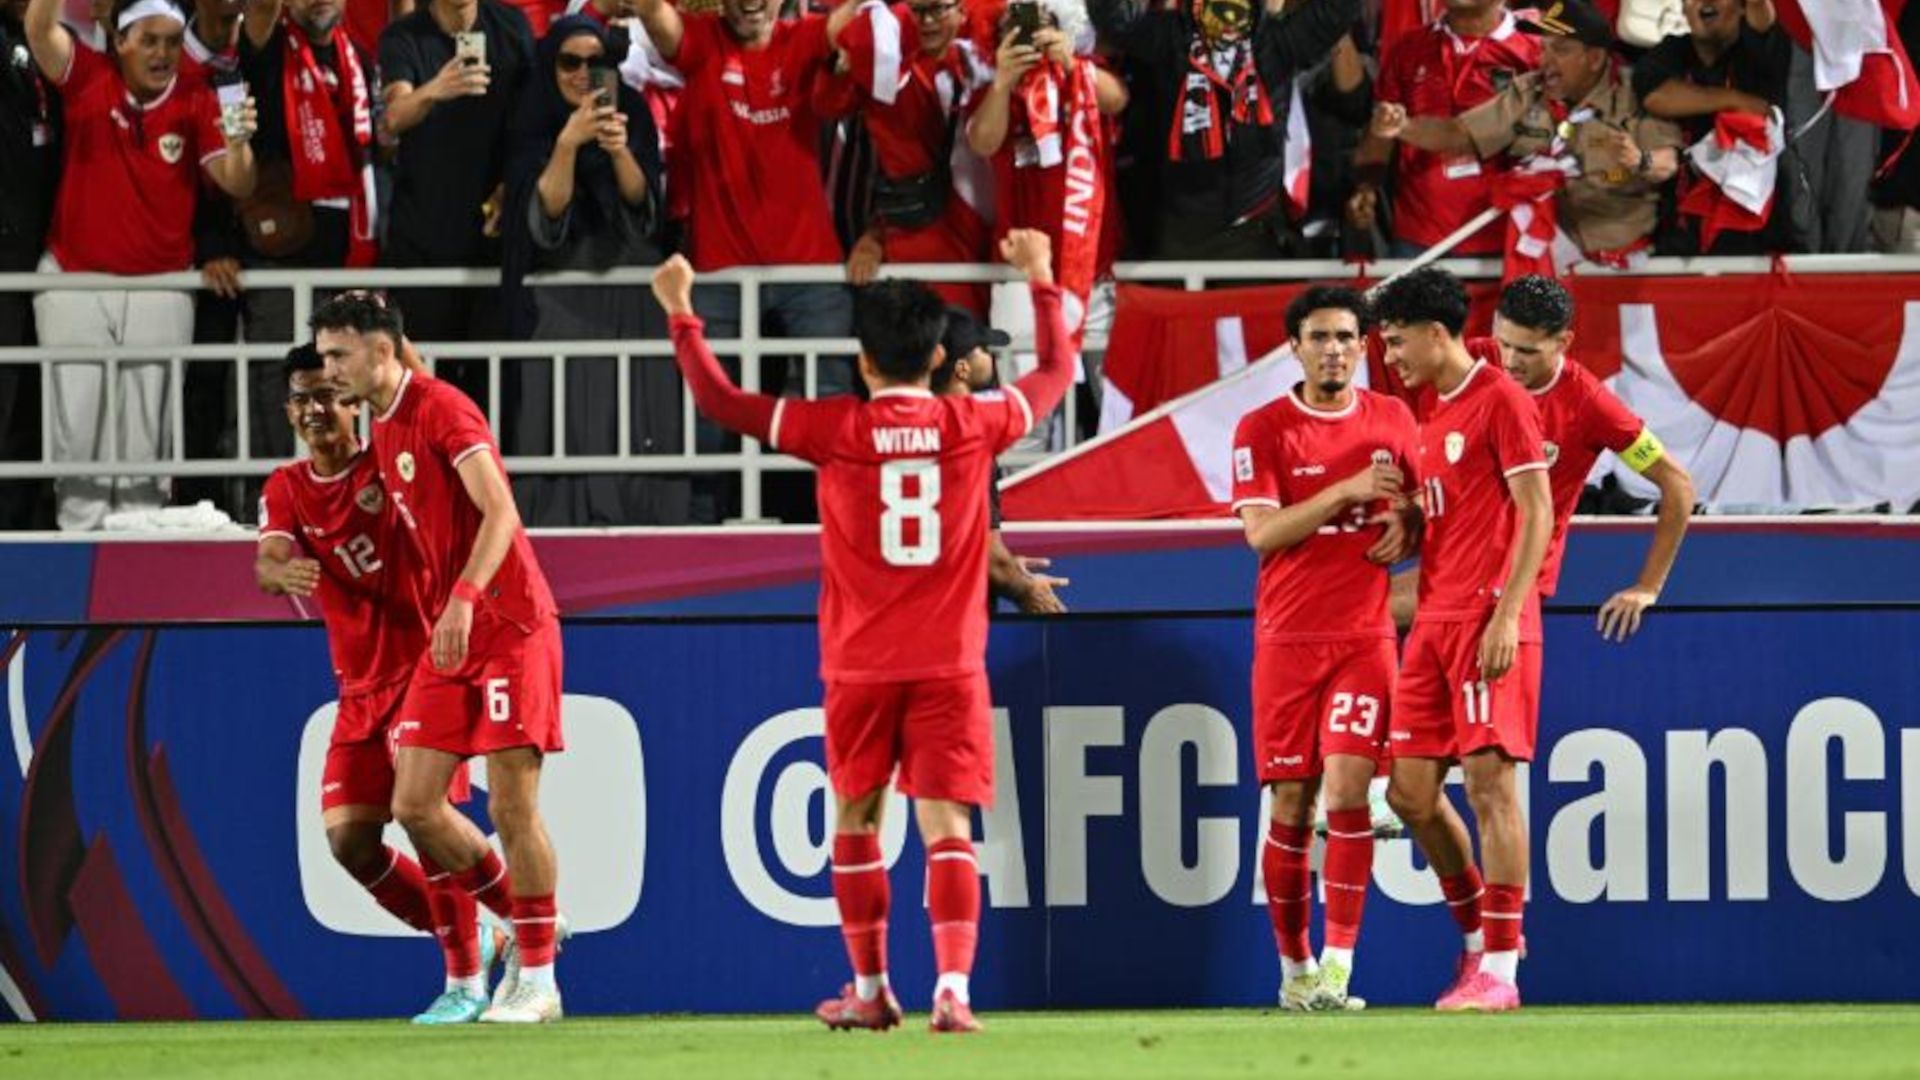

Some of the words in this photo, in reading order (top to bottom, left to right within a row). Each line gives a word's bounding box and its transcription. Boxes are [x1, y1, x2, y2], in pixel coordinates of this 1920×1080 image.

[871, 426, 941, 454] WITAN
[879, 457, 942, 567] 8
[333, 533, 384, 579] 12
[486, 677, 510, 722] 6
[1327, 691, 1380, 738] 23
[1462, 680, 1491, 724] 11
[720, 696, 1920, 928] @AFCanC
